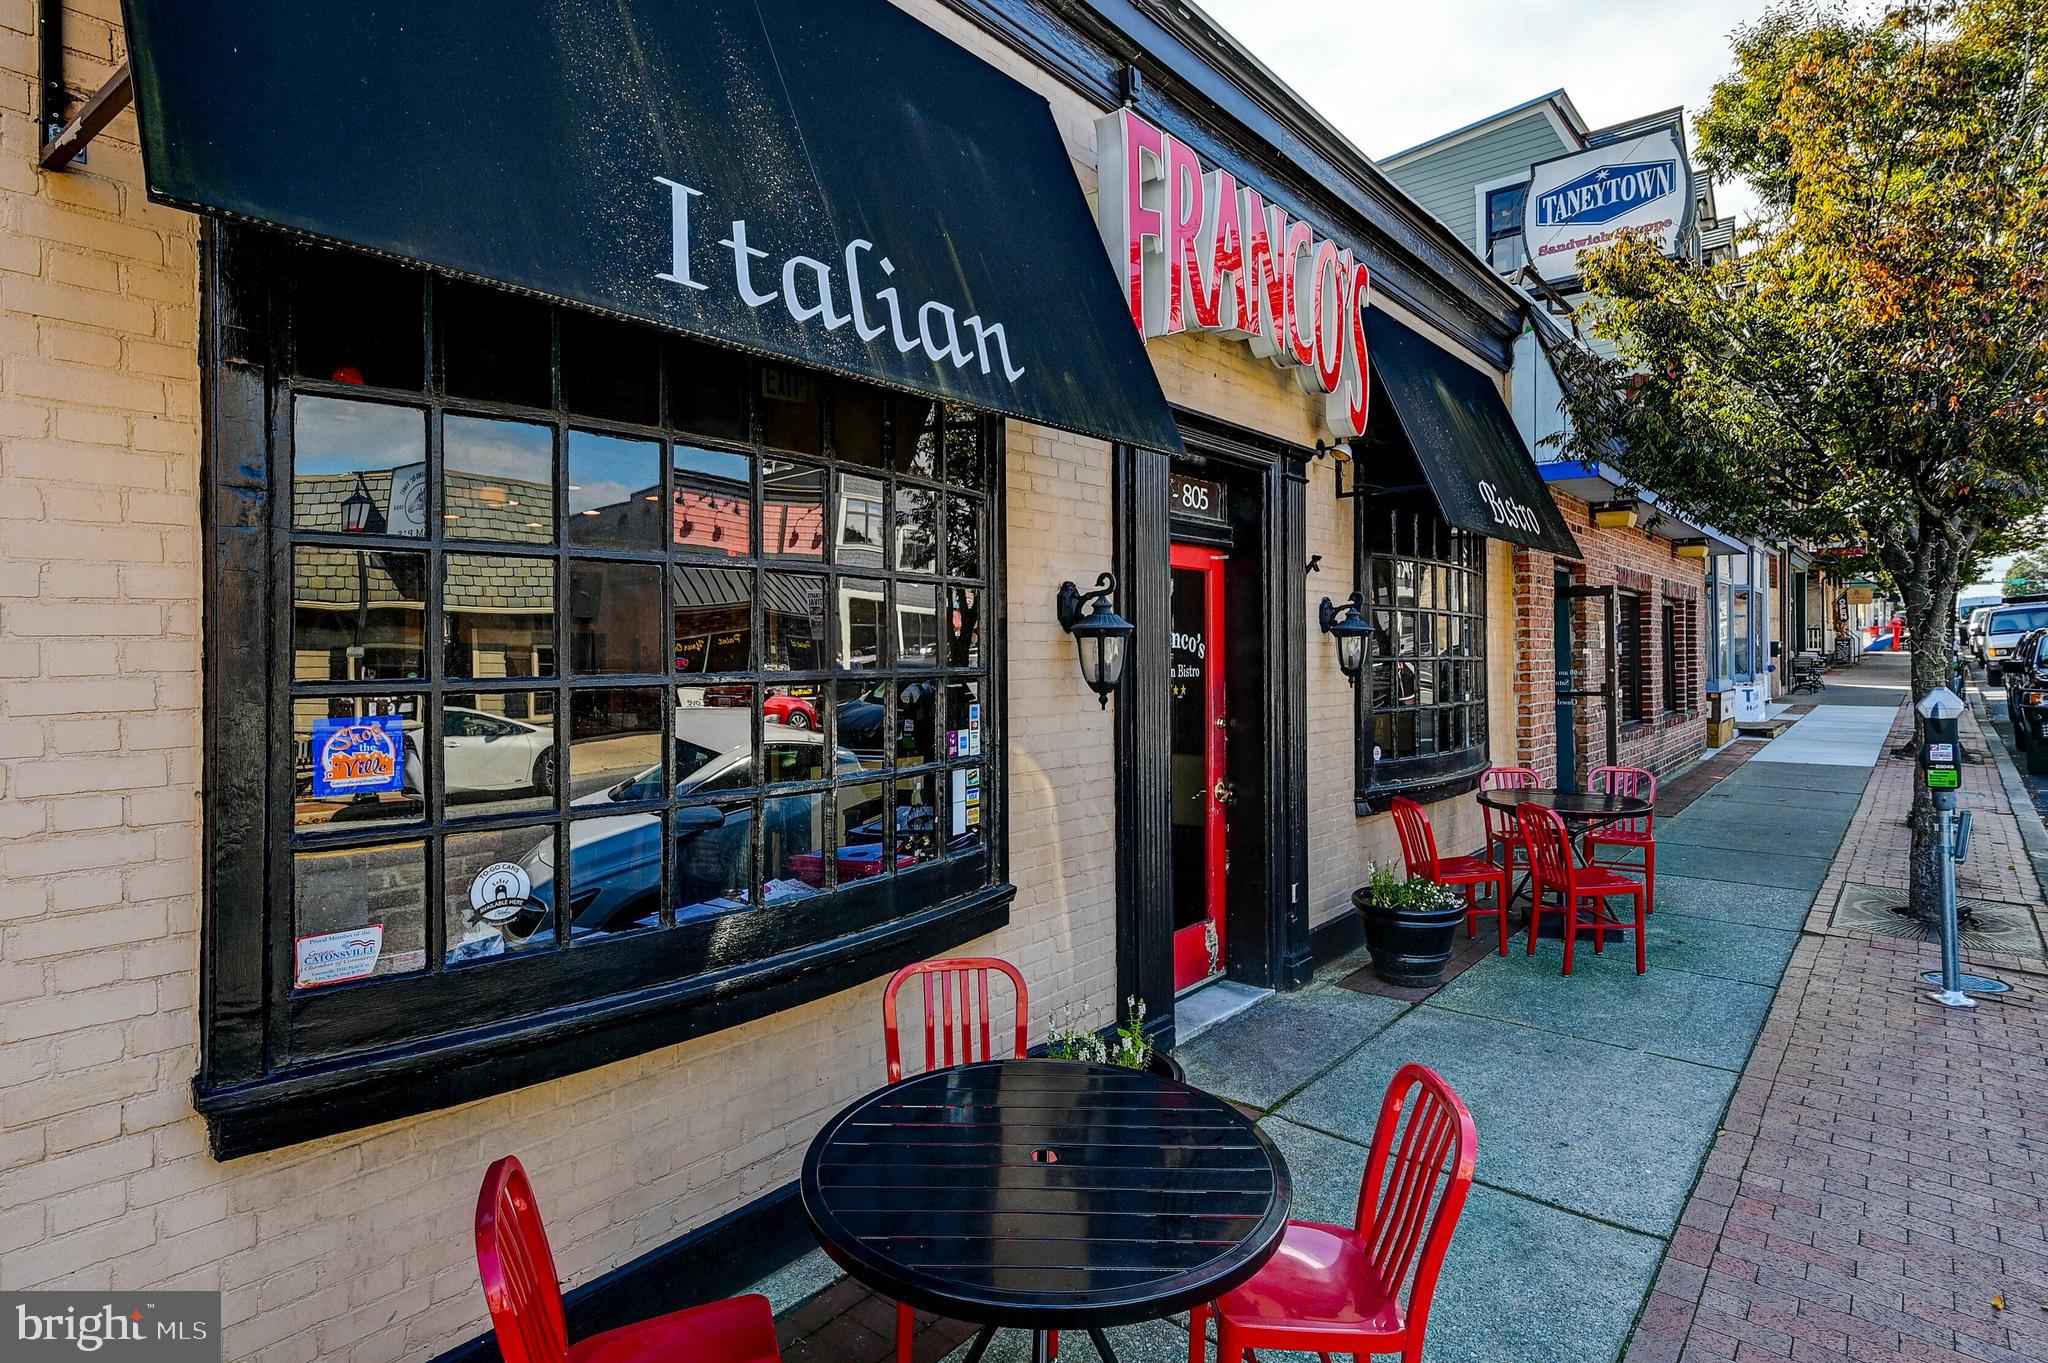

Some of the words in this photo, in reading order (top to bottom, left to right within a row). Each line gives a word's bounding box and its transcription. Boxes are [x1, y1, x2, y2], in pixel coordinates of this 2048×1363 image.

[1542, 164, 1671, 223] TANEYTOWN
[1538, 231, 1610, 257] Sandwich
[652, 176, 1025, 383] Italian
[1121, 107, 1370, 437] FRANCO'S
[1182, 483, 1209, 510] 805
[1478, 480, 1541, 535] Bistro
[1177, 664, 1200, 678] Bistro
[328, 726, 382, 750] Shop
[359, 742, 376, 752] the
[337, 757, 388, 777] Ville
[502, 863, 521, 873] CANS
[480, 899, 509, 914] AVAILABLE
[309, 936, 328, 945] Proud
[328, 931, 353, 942] Member
[304, 946, 376, 964] CATONSVILLE
[308, 949, 335, 958] Greater
[304, 961, 334, 972] Chamber
[343, 955, 376, 964] Commerce
